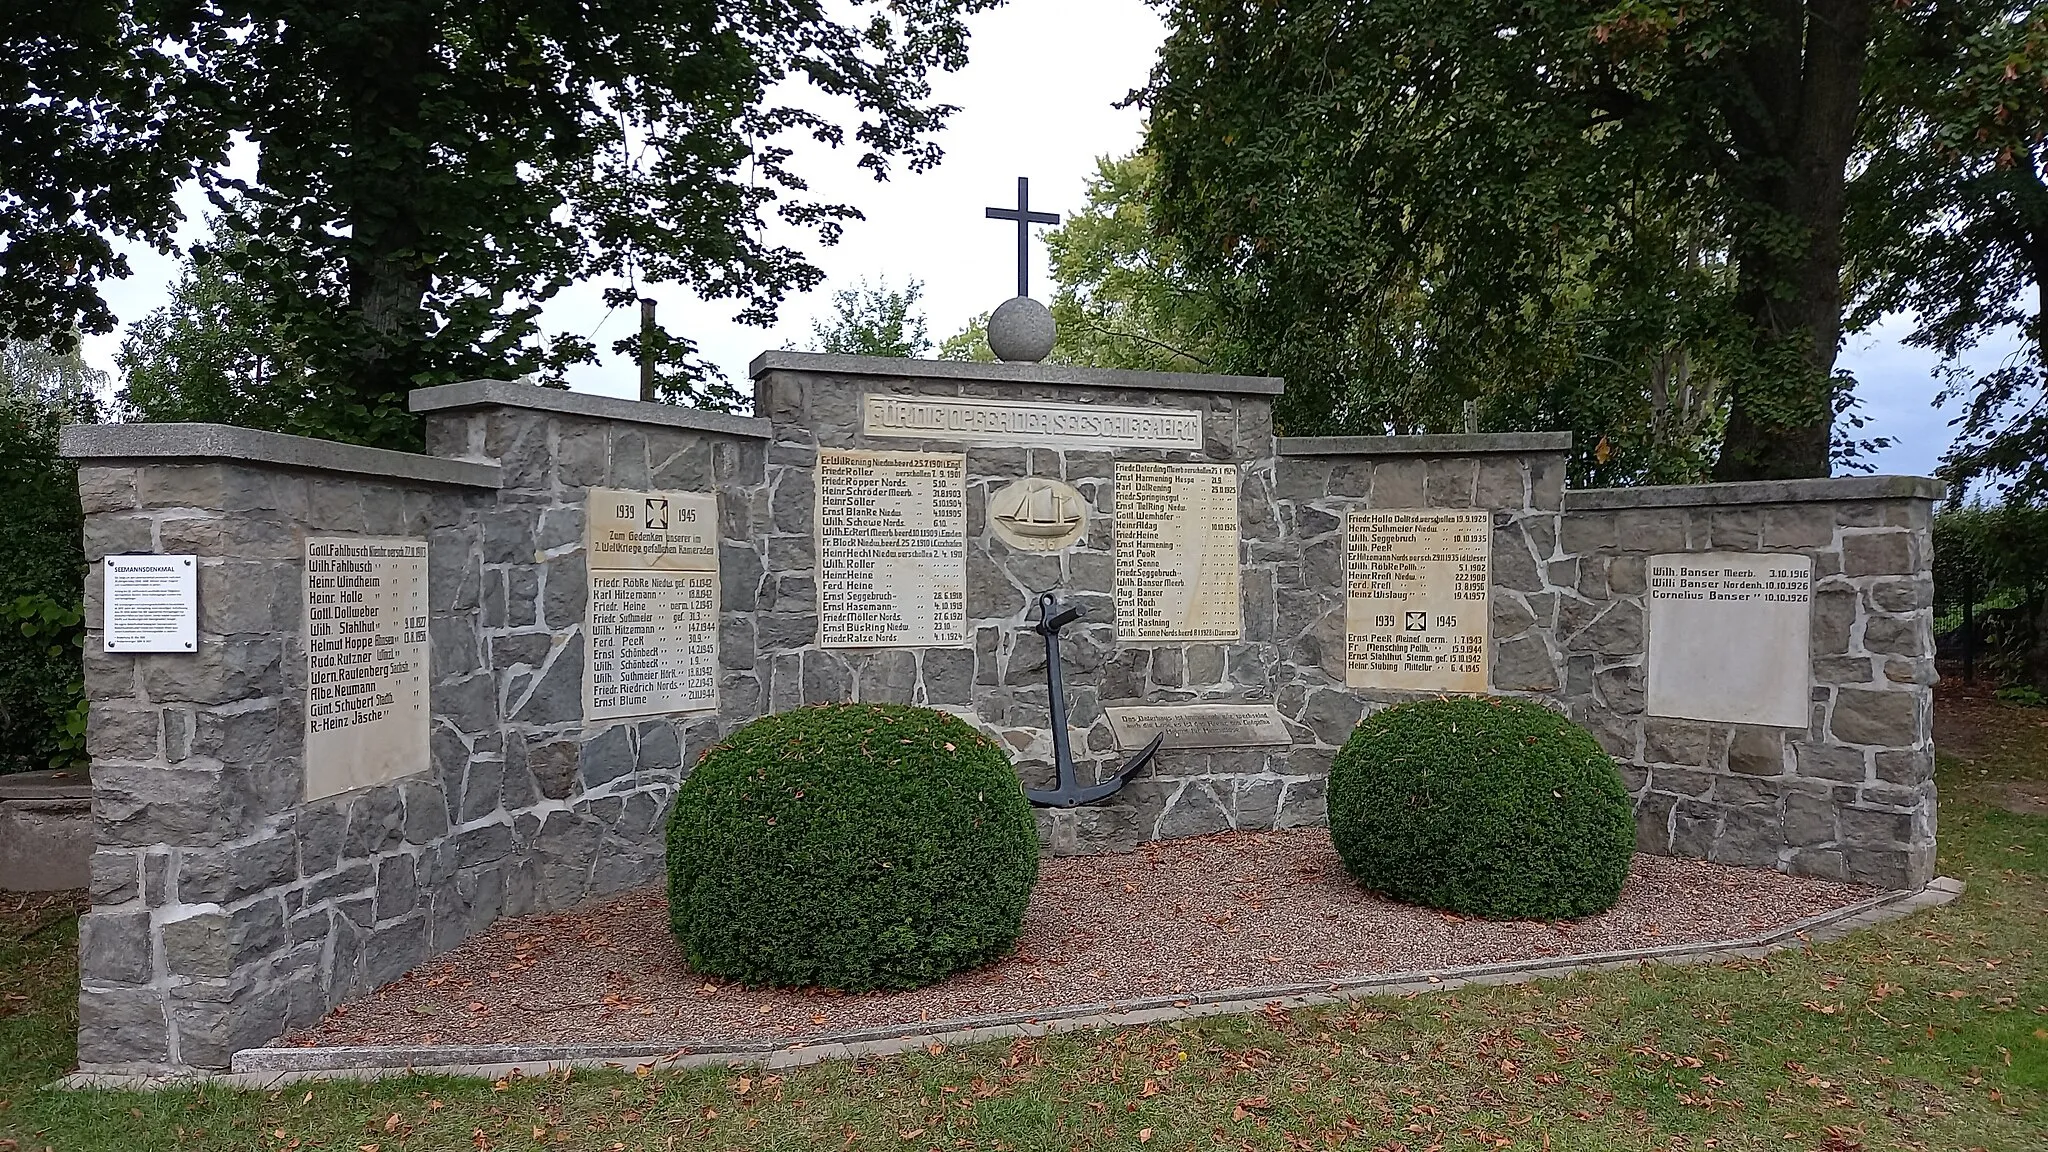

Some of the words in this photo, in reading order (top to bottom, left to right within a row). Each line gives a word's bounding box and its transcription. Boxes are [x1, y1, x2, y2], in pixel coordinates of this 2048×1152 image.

[1136, 474, 1172, 484] Harmening
[616, 505, 634, 518] 1939
[679, 509, 696, 522] 1945
[822, 507, 844, 516] Ernst
[847, 518, 881, 526] Schewe
[1136, 522, 1157, 531] Aldag
[610, 531, 625, 540] Zum
[629, 531, 662, 542] Gedenken
[1371, 534, 1416, 543] Seggebruch
[330, 544, 368, 556] Fahlbusch
[1136, 541, 1174, 550] Harmening
[331, 560, 372, 572] Fahlbusch
[847, 570, 874, 579] Heine
[1137, 569, 1177, 579] Seggebruch
[1653, 567, 1678, 576] Wilh.
[1680, 567, 1719, 576] Banser
[1724, 569, 1756, 577] Meerb.
[1769, 570, 1808, 578] 3.10.1916
[309, 576, 335, 588] Heinr.
[337, 576, 380, 587] Windheim
[847, 581, 873, 590] Heine
[1137, 579, 1163, 587] Banser
[1652, 578, 1675, 588] Willi
[1680, 579, 1719, 588] Banser
[1723, 581, 1765, 589] Nordenh.
[594, 590, 611, 599] Karl
[614, 590, 656, 599] Hitzemann
[823, 592, 844, 600] Ernst
[847, 591, 892, 602] Seggebruch
[1137, 588, 1163, 597] Banser
[1348, 590, 1371, 598] Heinz
[1652, 590, 1703, 599] Cornelius
[1709, 591, 1750, 600] Banser
[1764, 594, 1808, 602] 10.10.1926
[309, 592, 335, 604] Heinr.
[340, 591, 362, 603] Holle
[594, 602, 618, 611] Friedr.
[623, 602, 645, 610] Heine
[823, 602, 844, 611] Ernst
[847, 603, 891, 611] Hasemann
[1118, 598, 1135, 607] Ernst
[335, 606, 379, 619] Dollweber
[1118, 608, 1135, 617] Ernst
[1118, 618, 1135, 627] Ernst
[1375, 616, 1394, 627] 1939
[1436, 616, 1456, 627] 1945
[311, 622, 333, 636] Wilh.
[340, 621, 375, 634] Stahlhut
[614, 626, 654, 634] Hitzemann
[823, 623, 844, 632] Ernst
[1138, 628, 1161, 637] Senne
[594, 638, 615, 647] Ferd.
[1348, 634, 1368, 642] Ernst
[311, 639, 342, 652] Helmut
[345, 637, 372, 650] Hoppe
[1366, 644, 1408, 653] Mensching
[594, 650, 614, 659] Ernst
[1348, 652, 1368, 660] Ernst
[594, 662, 614, 671] Wilh.
[1348, 662, 1370, 670] Heinr.
[339, 666, 388, 681] Rautenberg
[594, 674, 614, 683] Wilh.
[621, 671, 658, 681] Suthmeier
[334, 683, 376, 697] Neumann
[594, 685, 618, 695] Friedr.
[620, 683, 654, 694] Riedrich
[335, 696, 373, 713] Schubert
[594, 697, 615, 707] Ernst
[620, 696, 646, 705] Blume
